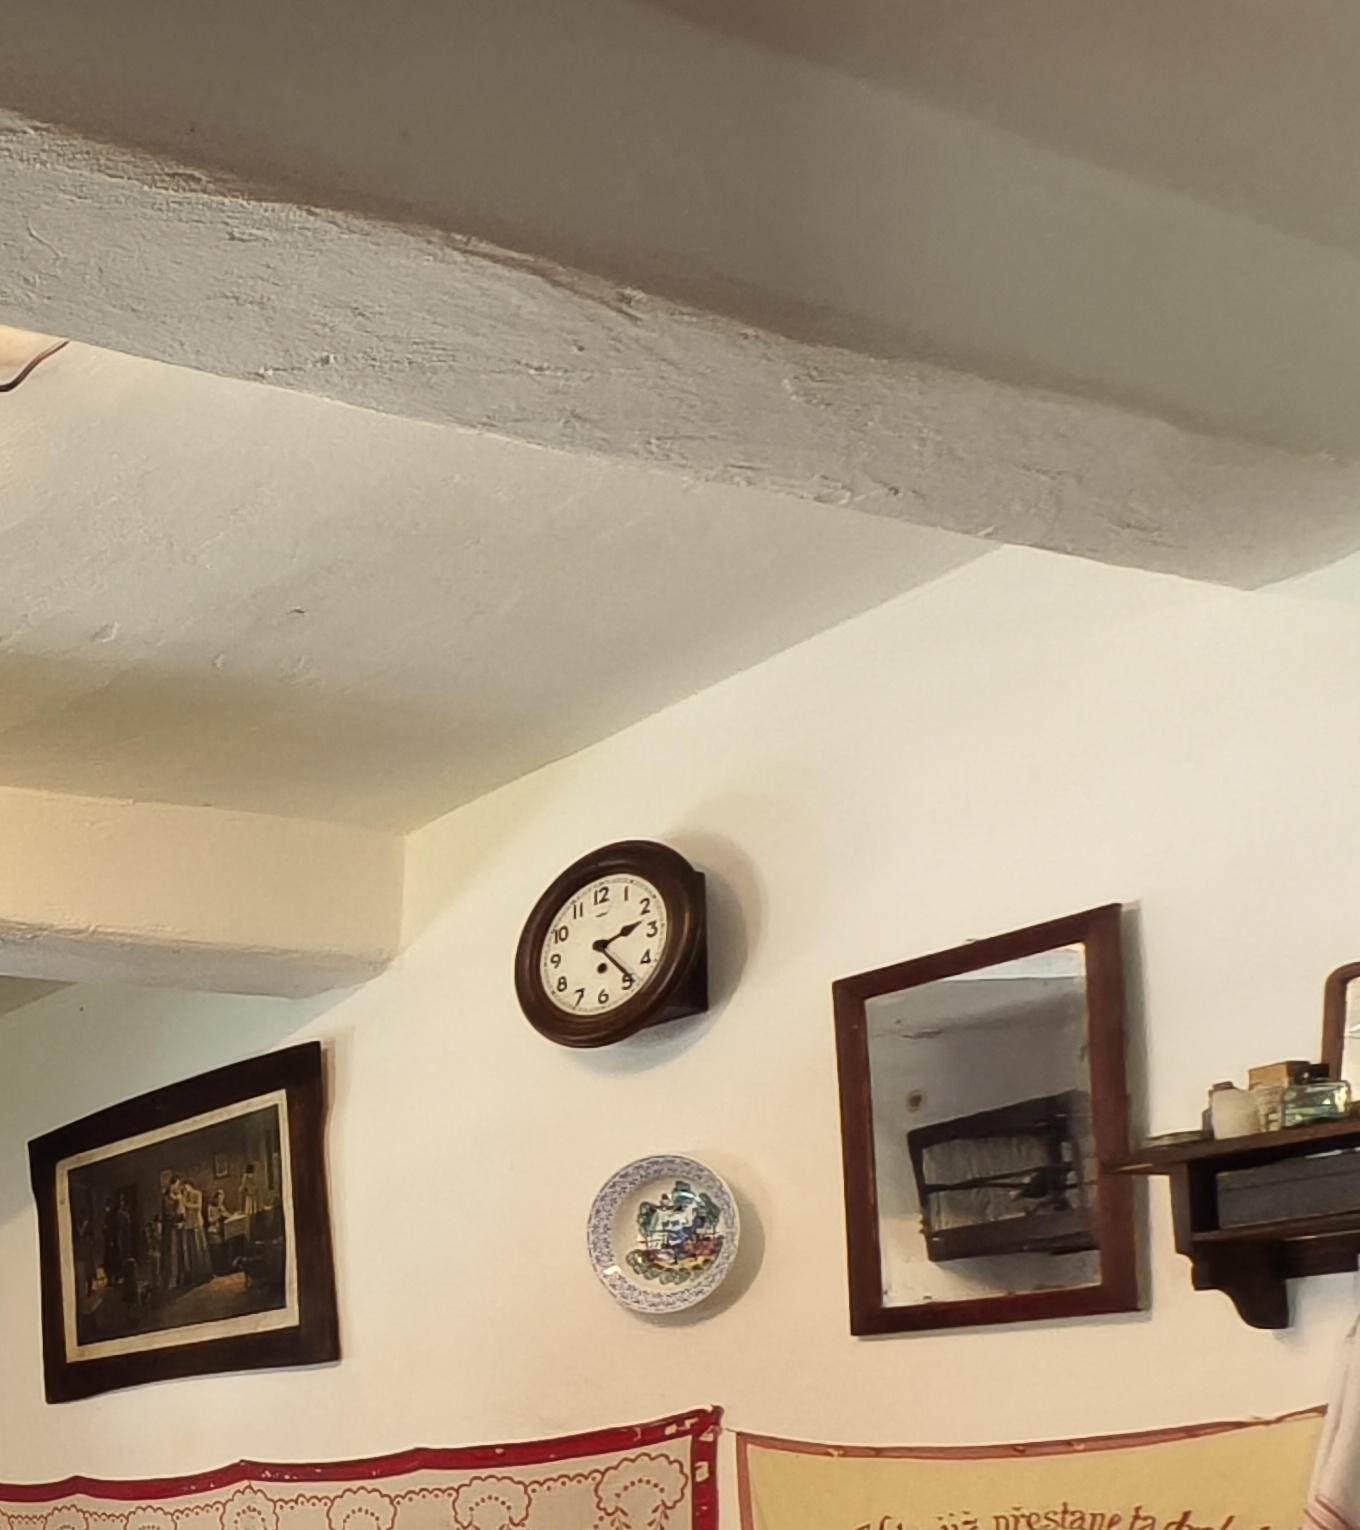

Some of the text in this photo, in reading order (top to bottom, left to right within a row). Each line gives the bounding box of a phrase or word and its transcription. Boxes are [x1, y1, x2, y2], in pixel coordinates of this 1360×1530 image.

[594, 887, 609, 905] 12
[623, 886, 629, 901] 1
[573, 902, 583, 919] 11
[640, 898, 650, 915] 2
[554, 926, 569, 944] 10
[646, 920, 658, 938] 3
[550, 954, 561, 969] 9
[640, 948, 651, 964] 4
[557, 976, 567, 992] 8
[575, 988, 585, 1006] 7
[598, 989, 609, 1004] 6
